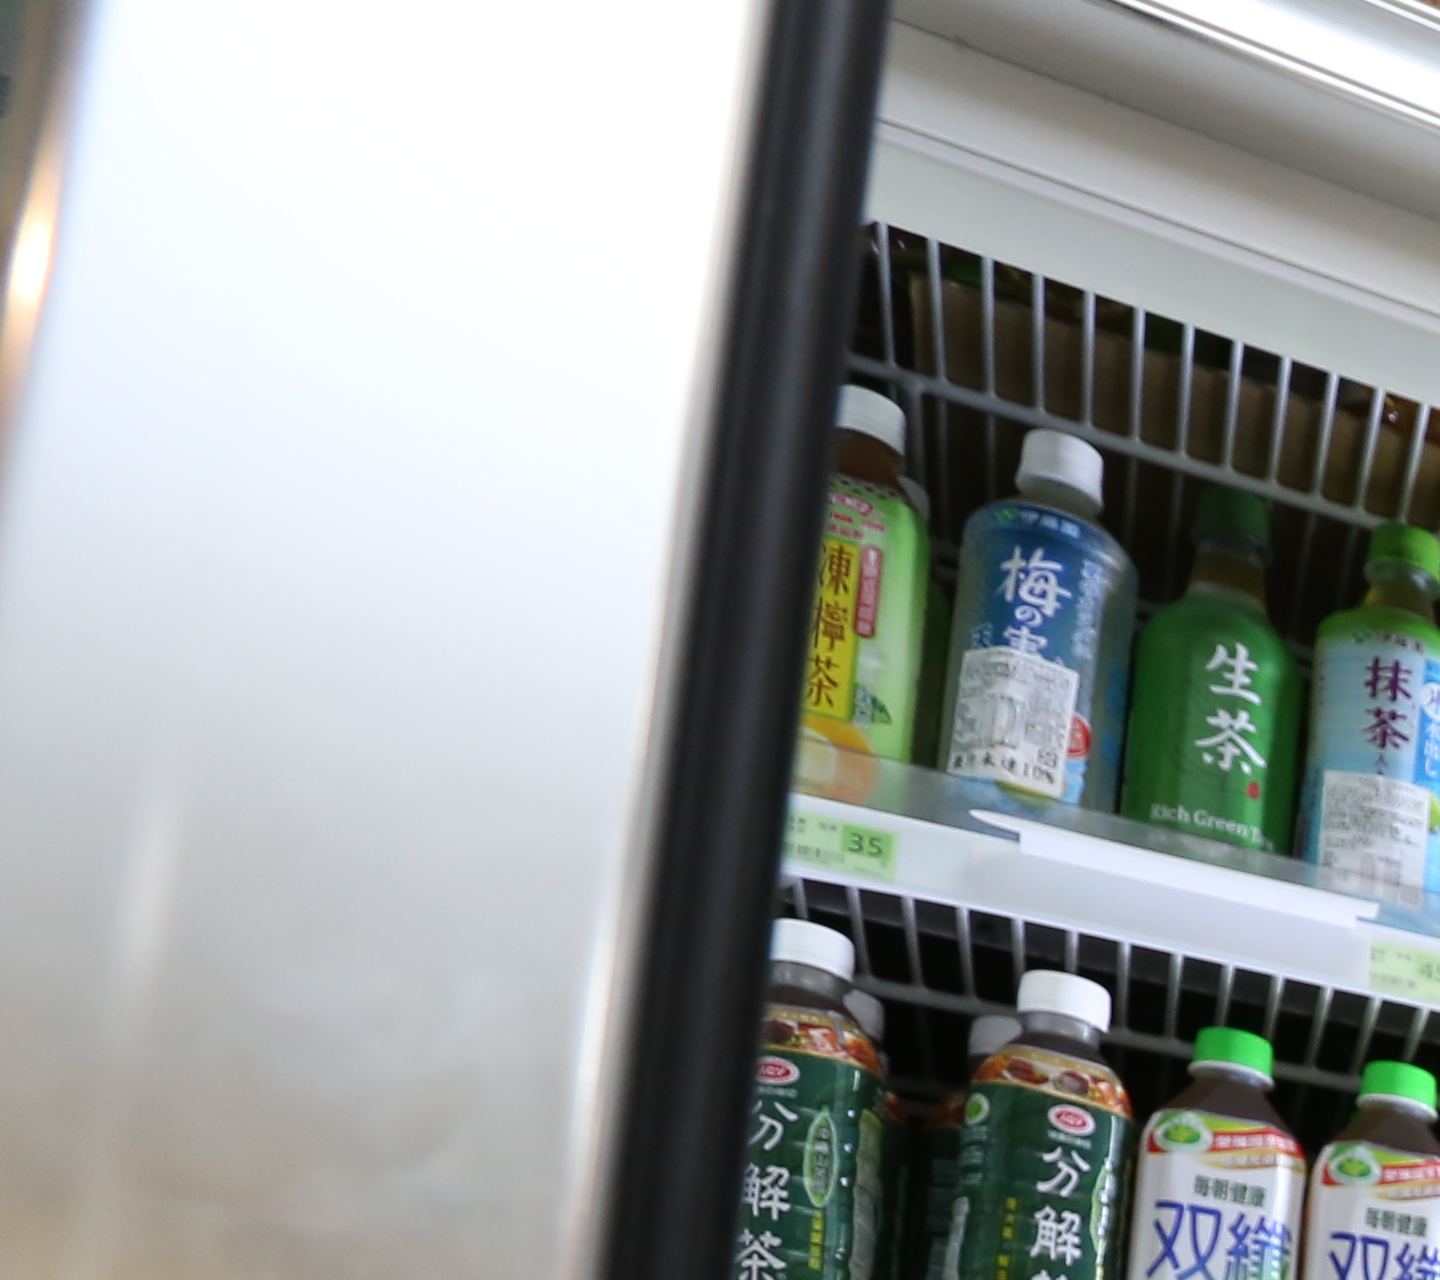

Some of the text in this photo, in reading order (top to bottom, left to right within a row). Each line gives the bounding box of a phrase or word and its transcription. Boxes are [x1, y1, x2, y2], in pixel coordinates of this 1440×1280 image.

[1195, 642, 1268, 776] 生茶
[1362, 656, 1413, 750] 抹茶
[847, 832, 883, 857] 35
[1193, 1174, 1266, 1208] 每朝健康
[1364, 1207, 1428, 1238] 每朝健康
